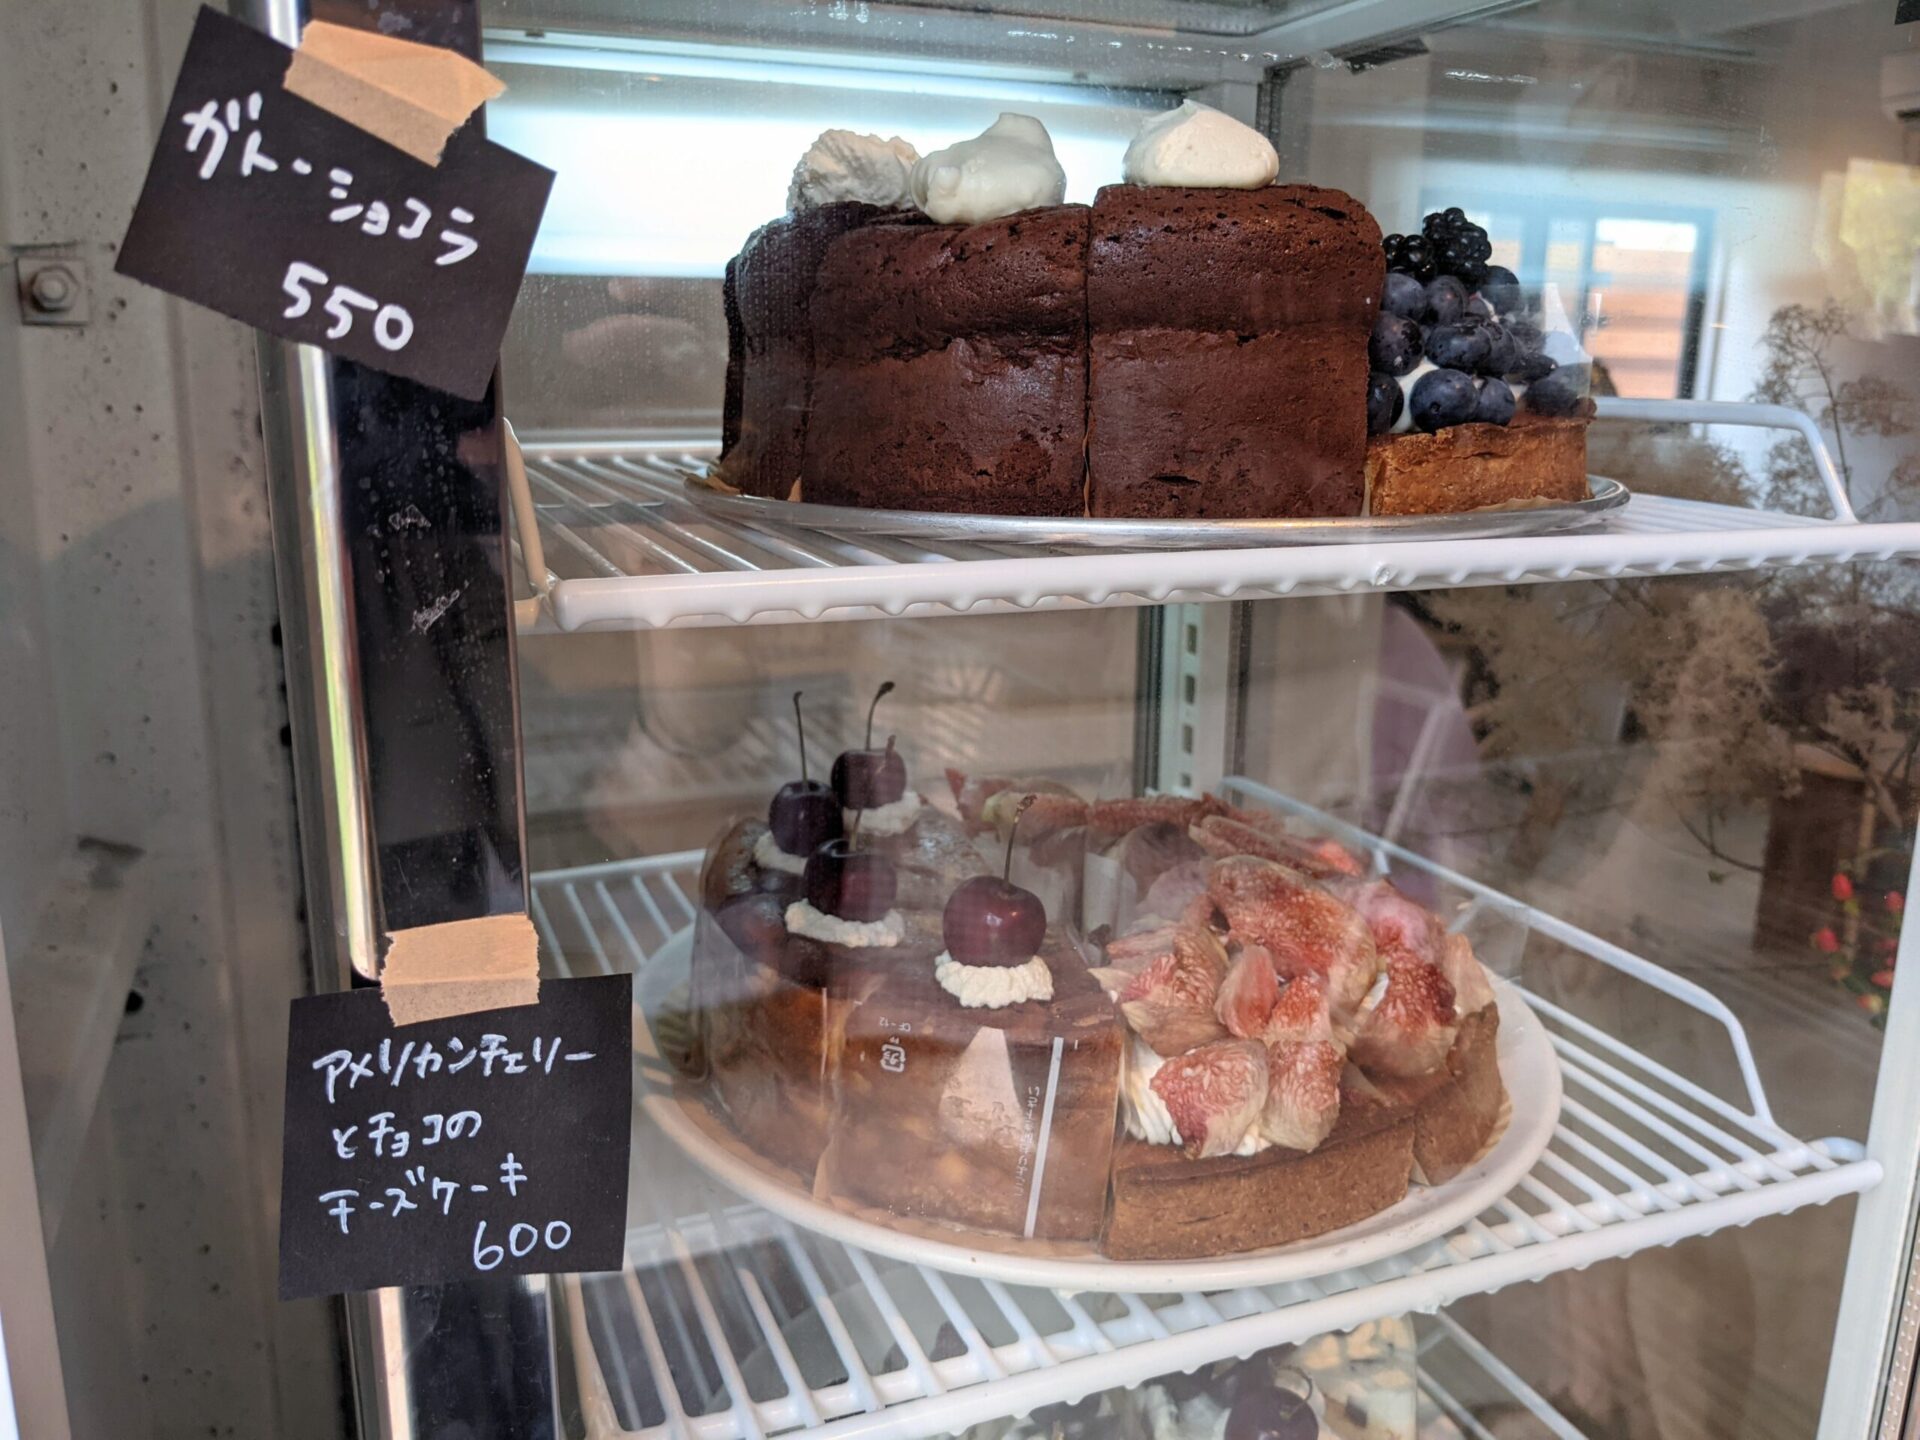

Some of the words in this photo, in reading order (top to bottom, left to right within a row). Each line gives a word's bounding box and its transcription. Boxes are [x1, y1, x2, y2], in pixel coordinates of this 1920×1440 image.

[183, 92, 479, 266] ガトーショコラ
[282, 261, 414, 351] 550
[312, 1033, 598, 1104] アメリカンチェリー
[332, 1110, 483, 1159] とチョコの
[318, 1152, 528, 1235] チーズケーキ
[473, 1220, 572, 1271] 600
